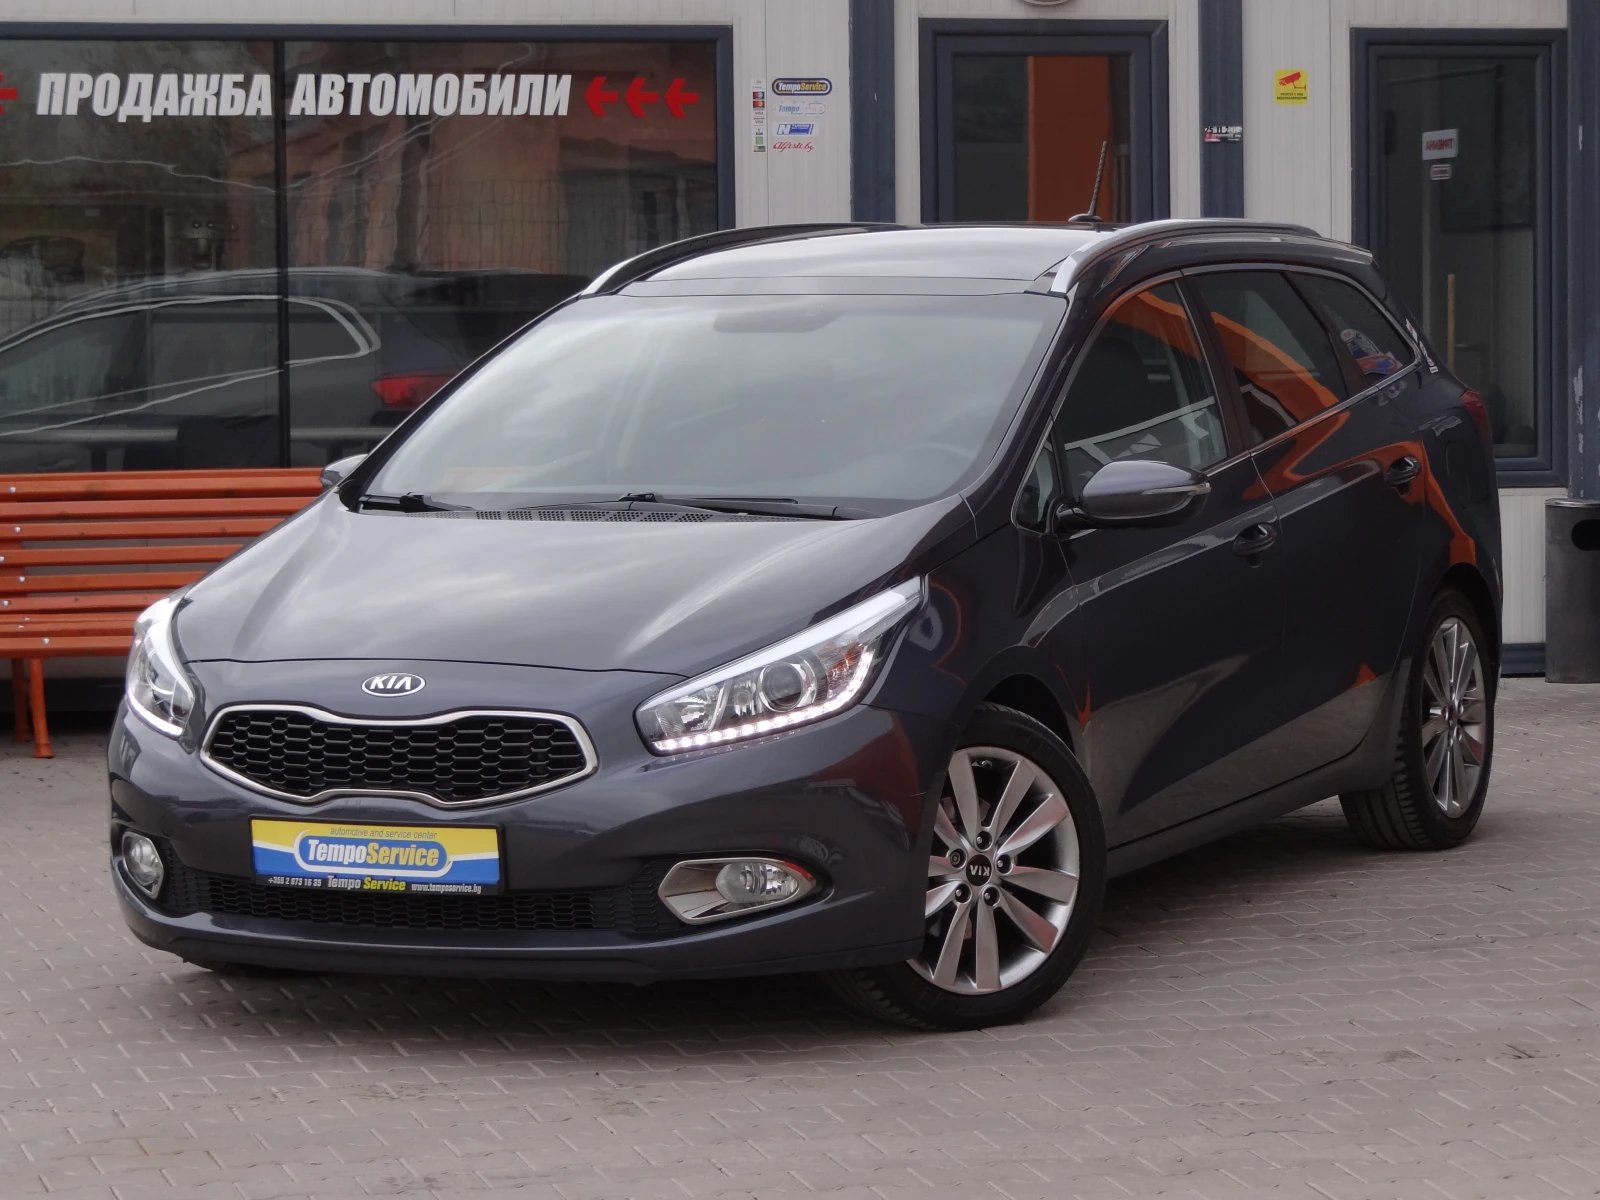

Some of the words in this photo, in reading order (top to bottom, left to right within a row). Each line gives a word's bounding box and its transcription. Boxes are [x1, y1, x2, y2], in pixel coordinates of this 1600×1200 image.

[36, 73, 273, 123] ПРОДАЖБА
[289, 73, 572, 116] АВТОМОБИЛИ
[369, 675, 412, 690] KIA
[329, 827, 368, 837] automotive
[369, 830, 384, 838] and
[385, 831, 412, 839] service
[413, 832, 437, 840] center
[308, 839, 440, 867] TempoService
[970, 864, 990, 877] KIA
[327, 875, 361, 890] Tempo
[363, 877, 407, 891] Service
[411, 883, 482, 894] www.temposervice.bg
